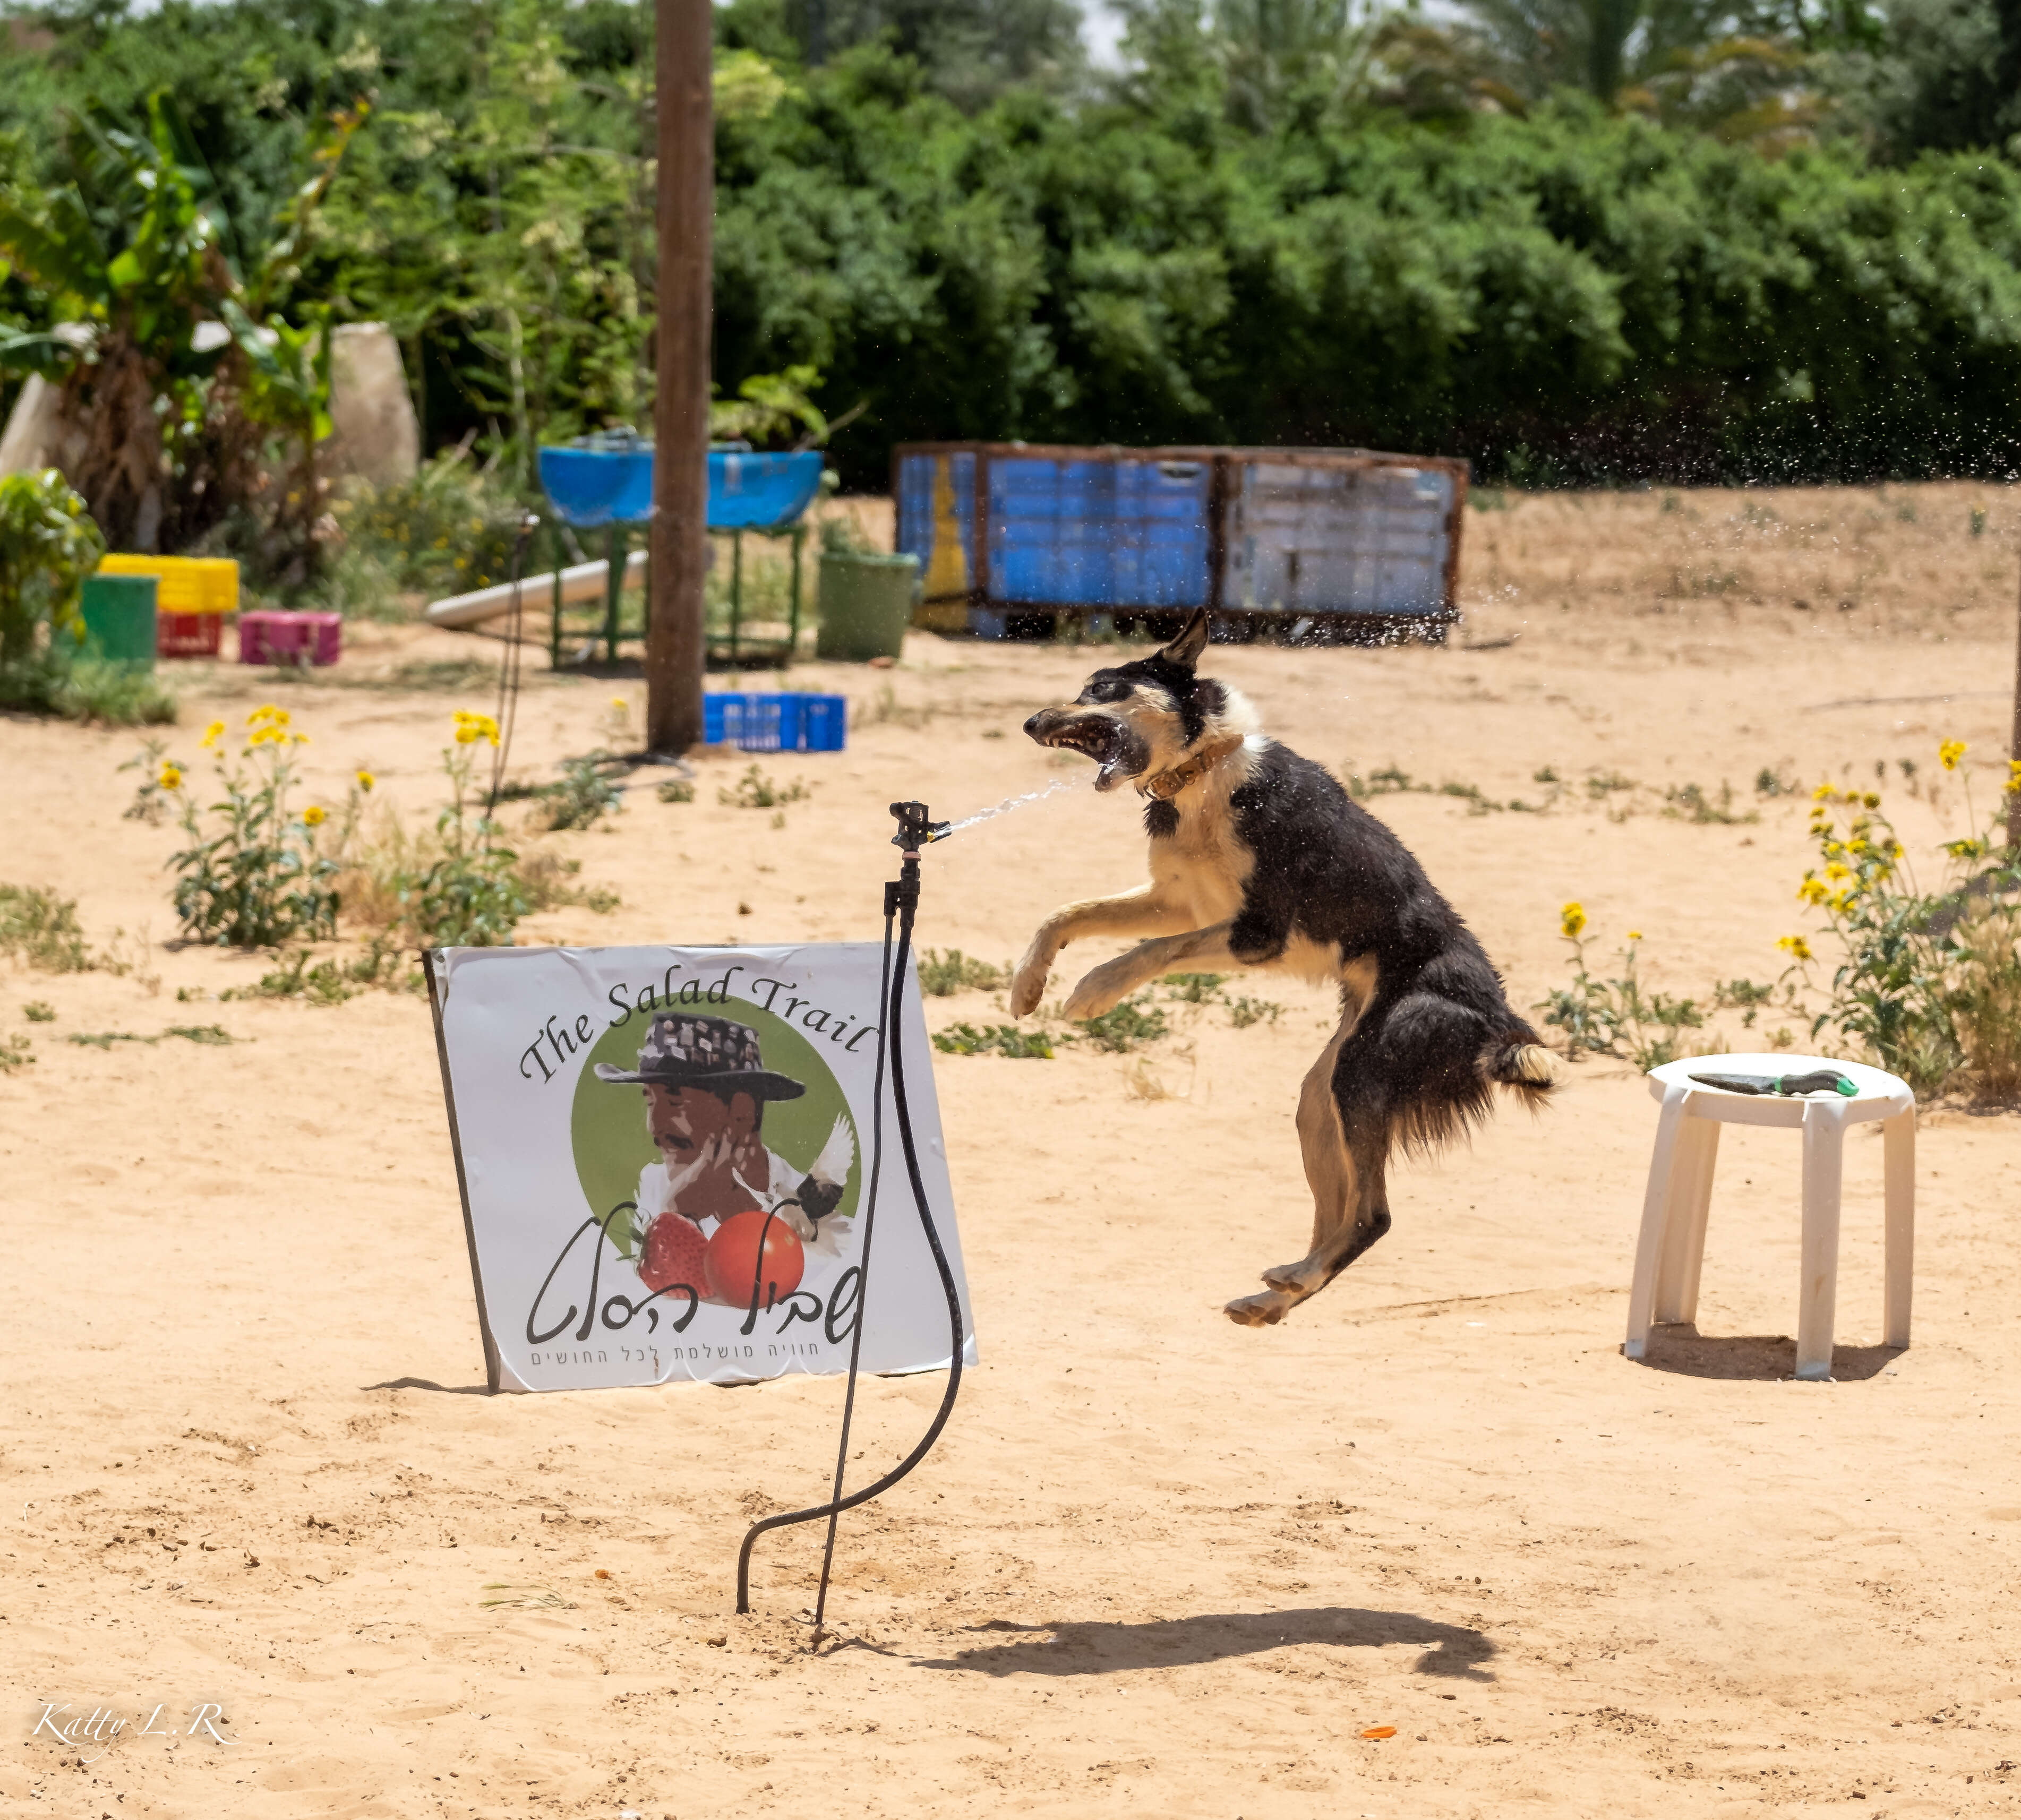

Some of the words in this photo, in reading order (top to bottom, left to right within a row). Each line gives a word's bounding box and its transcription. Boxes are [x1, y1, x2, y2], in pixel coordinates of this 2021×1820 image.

[519, 1014, 594, 1085] The
[608, 964, 744, 1027] Salad
[751, 977, 880, 1052] Trail
[526, 1201, 698, 1344] הסלט
[741, 1198, 862, 1344] שביל
[531, 1349, 608, 1366] החושים
[621, 1345, 658, 1362] לכל
[673, 1343, 753, 1360] מושלמת
[768, 1343, 819, 1357] חוויה
